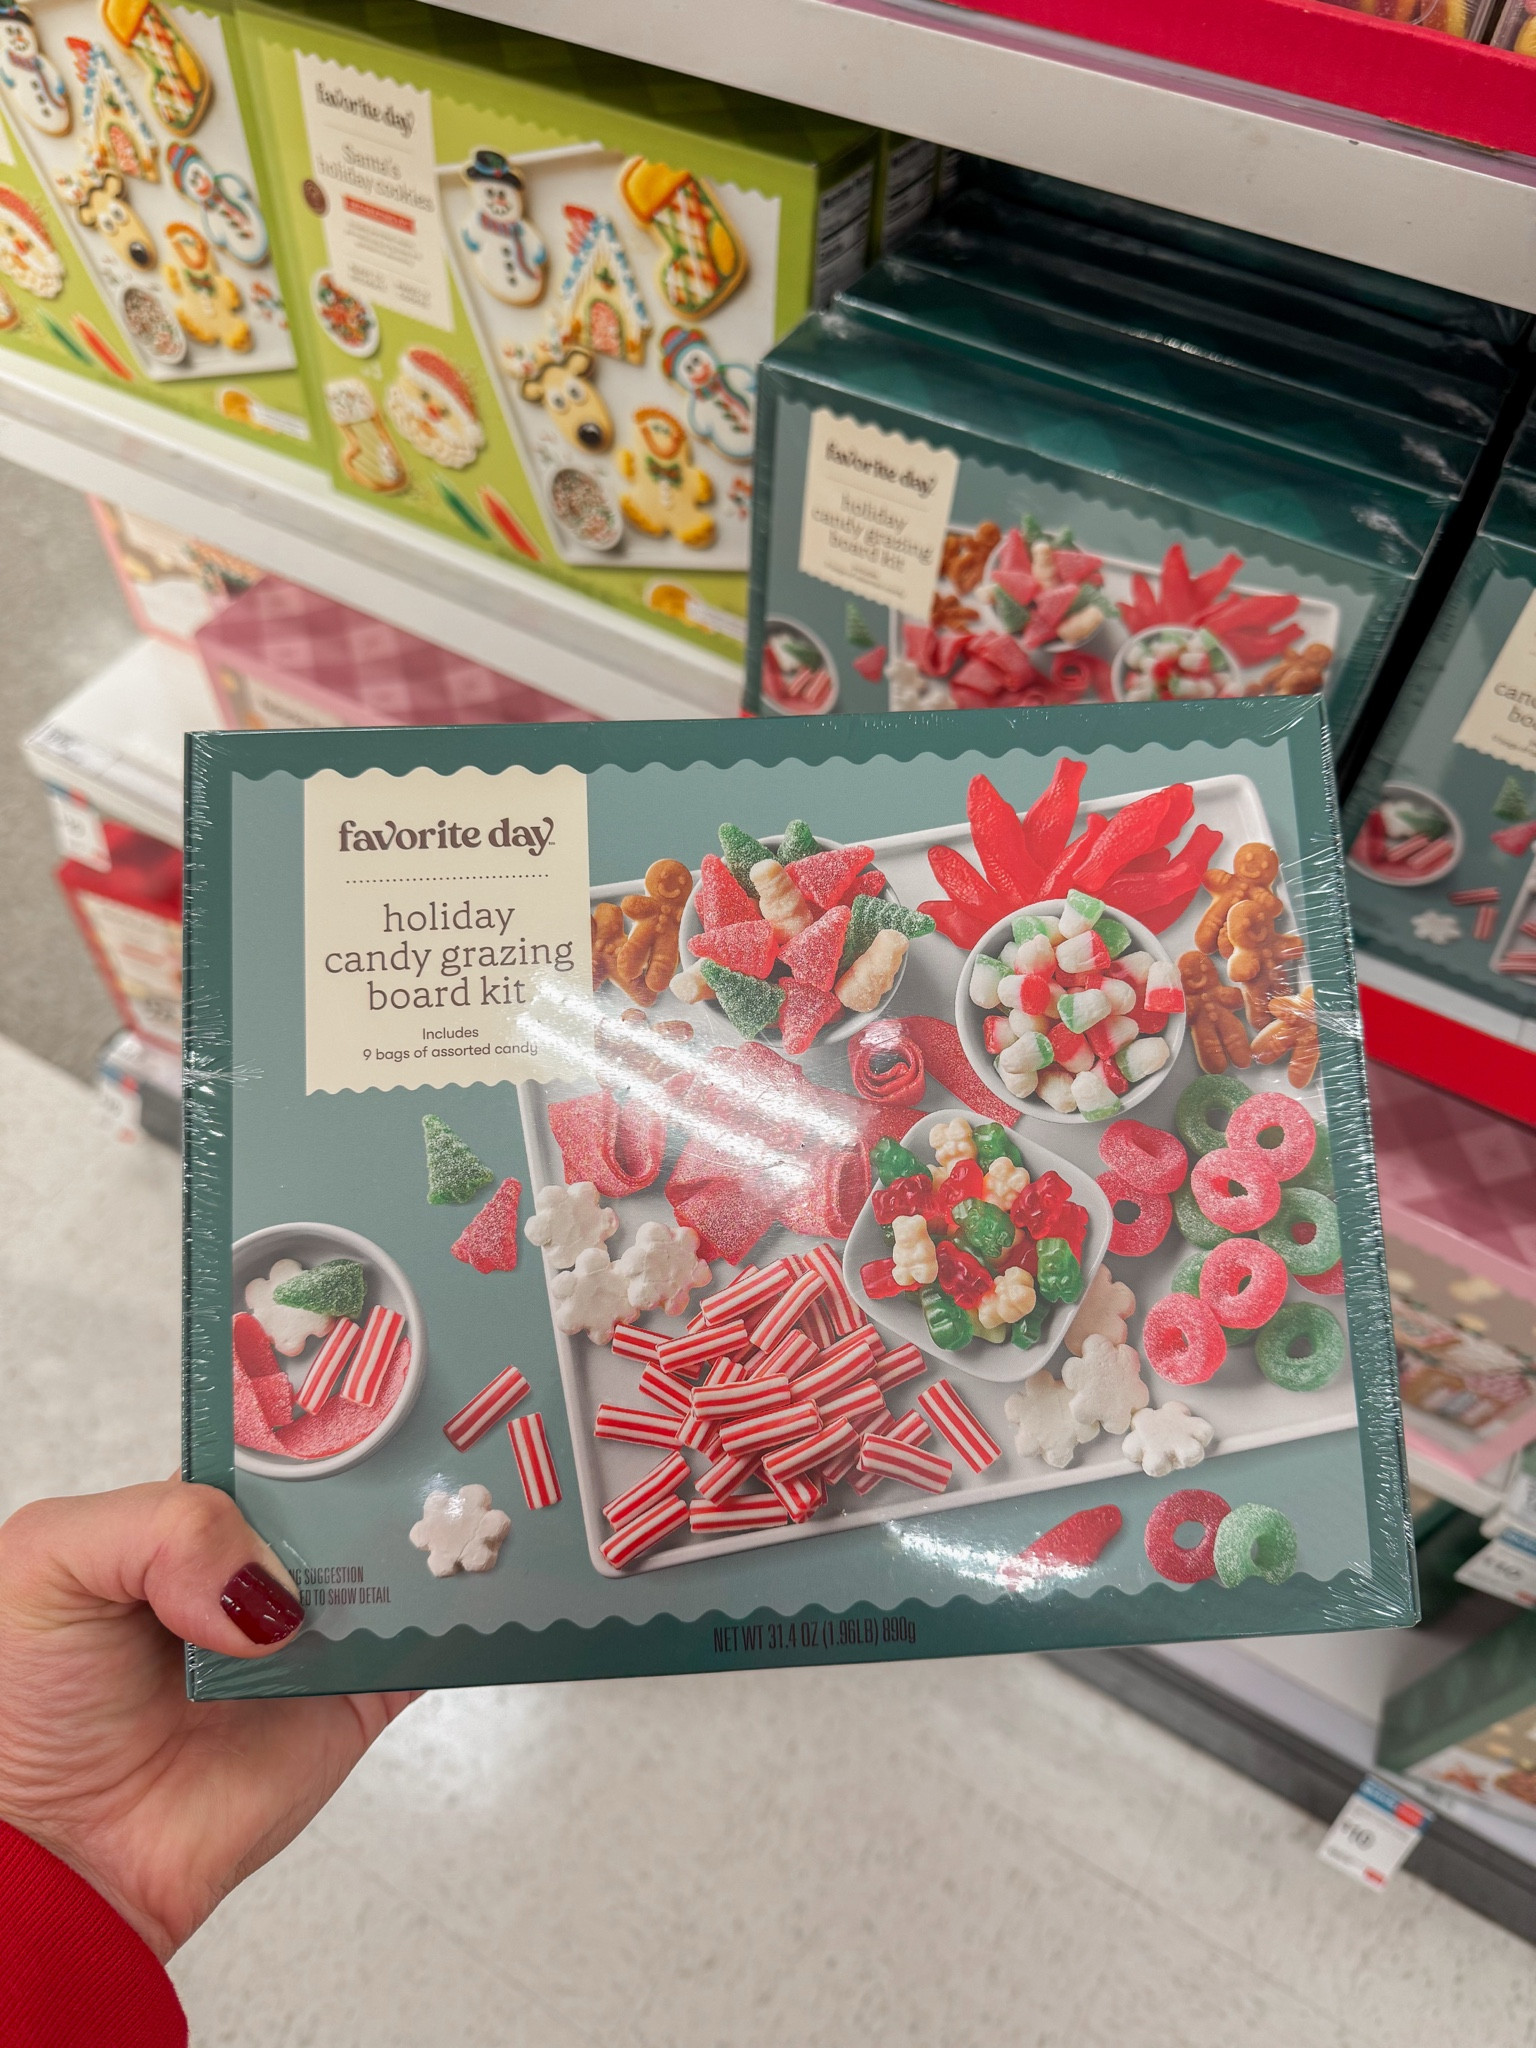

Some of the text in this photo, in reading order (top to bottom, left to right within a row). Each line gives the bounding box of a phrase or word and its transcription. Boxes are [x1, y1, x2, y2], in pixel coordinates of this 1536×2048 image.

[824, 438, 937, 499] favorite day
[339, 819, 482, 852] favorite
[383, 900, 516, 936] holiday
[325, 937, 575, 978] candy grazing
[367, 974, 527, 1011] board kit
[422, 1026, 479, 1041] Includes
[362, 1041, 538, 1063] 9 bags of assorted candy
[304, 1566, 364, 1586] SUGGESTION
[314, 1589, 326, 1606] TO
[328, 1587, 357, 1606] SHOW
[360, 1585, 391, 1605] DETAIL
[713, 1615, 916, 1653] NET WT 31.4 OZ (1.96LB) 890g
